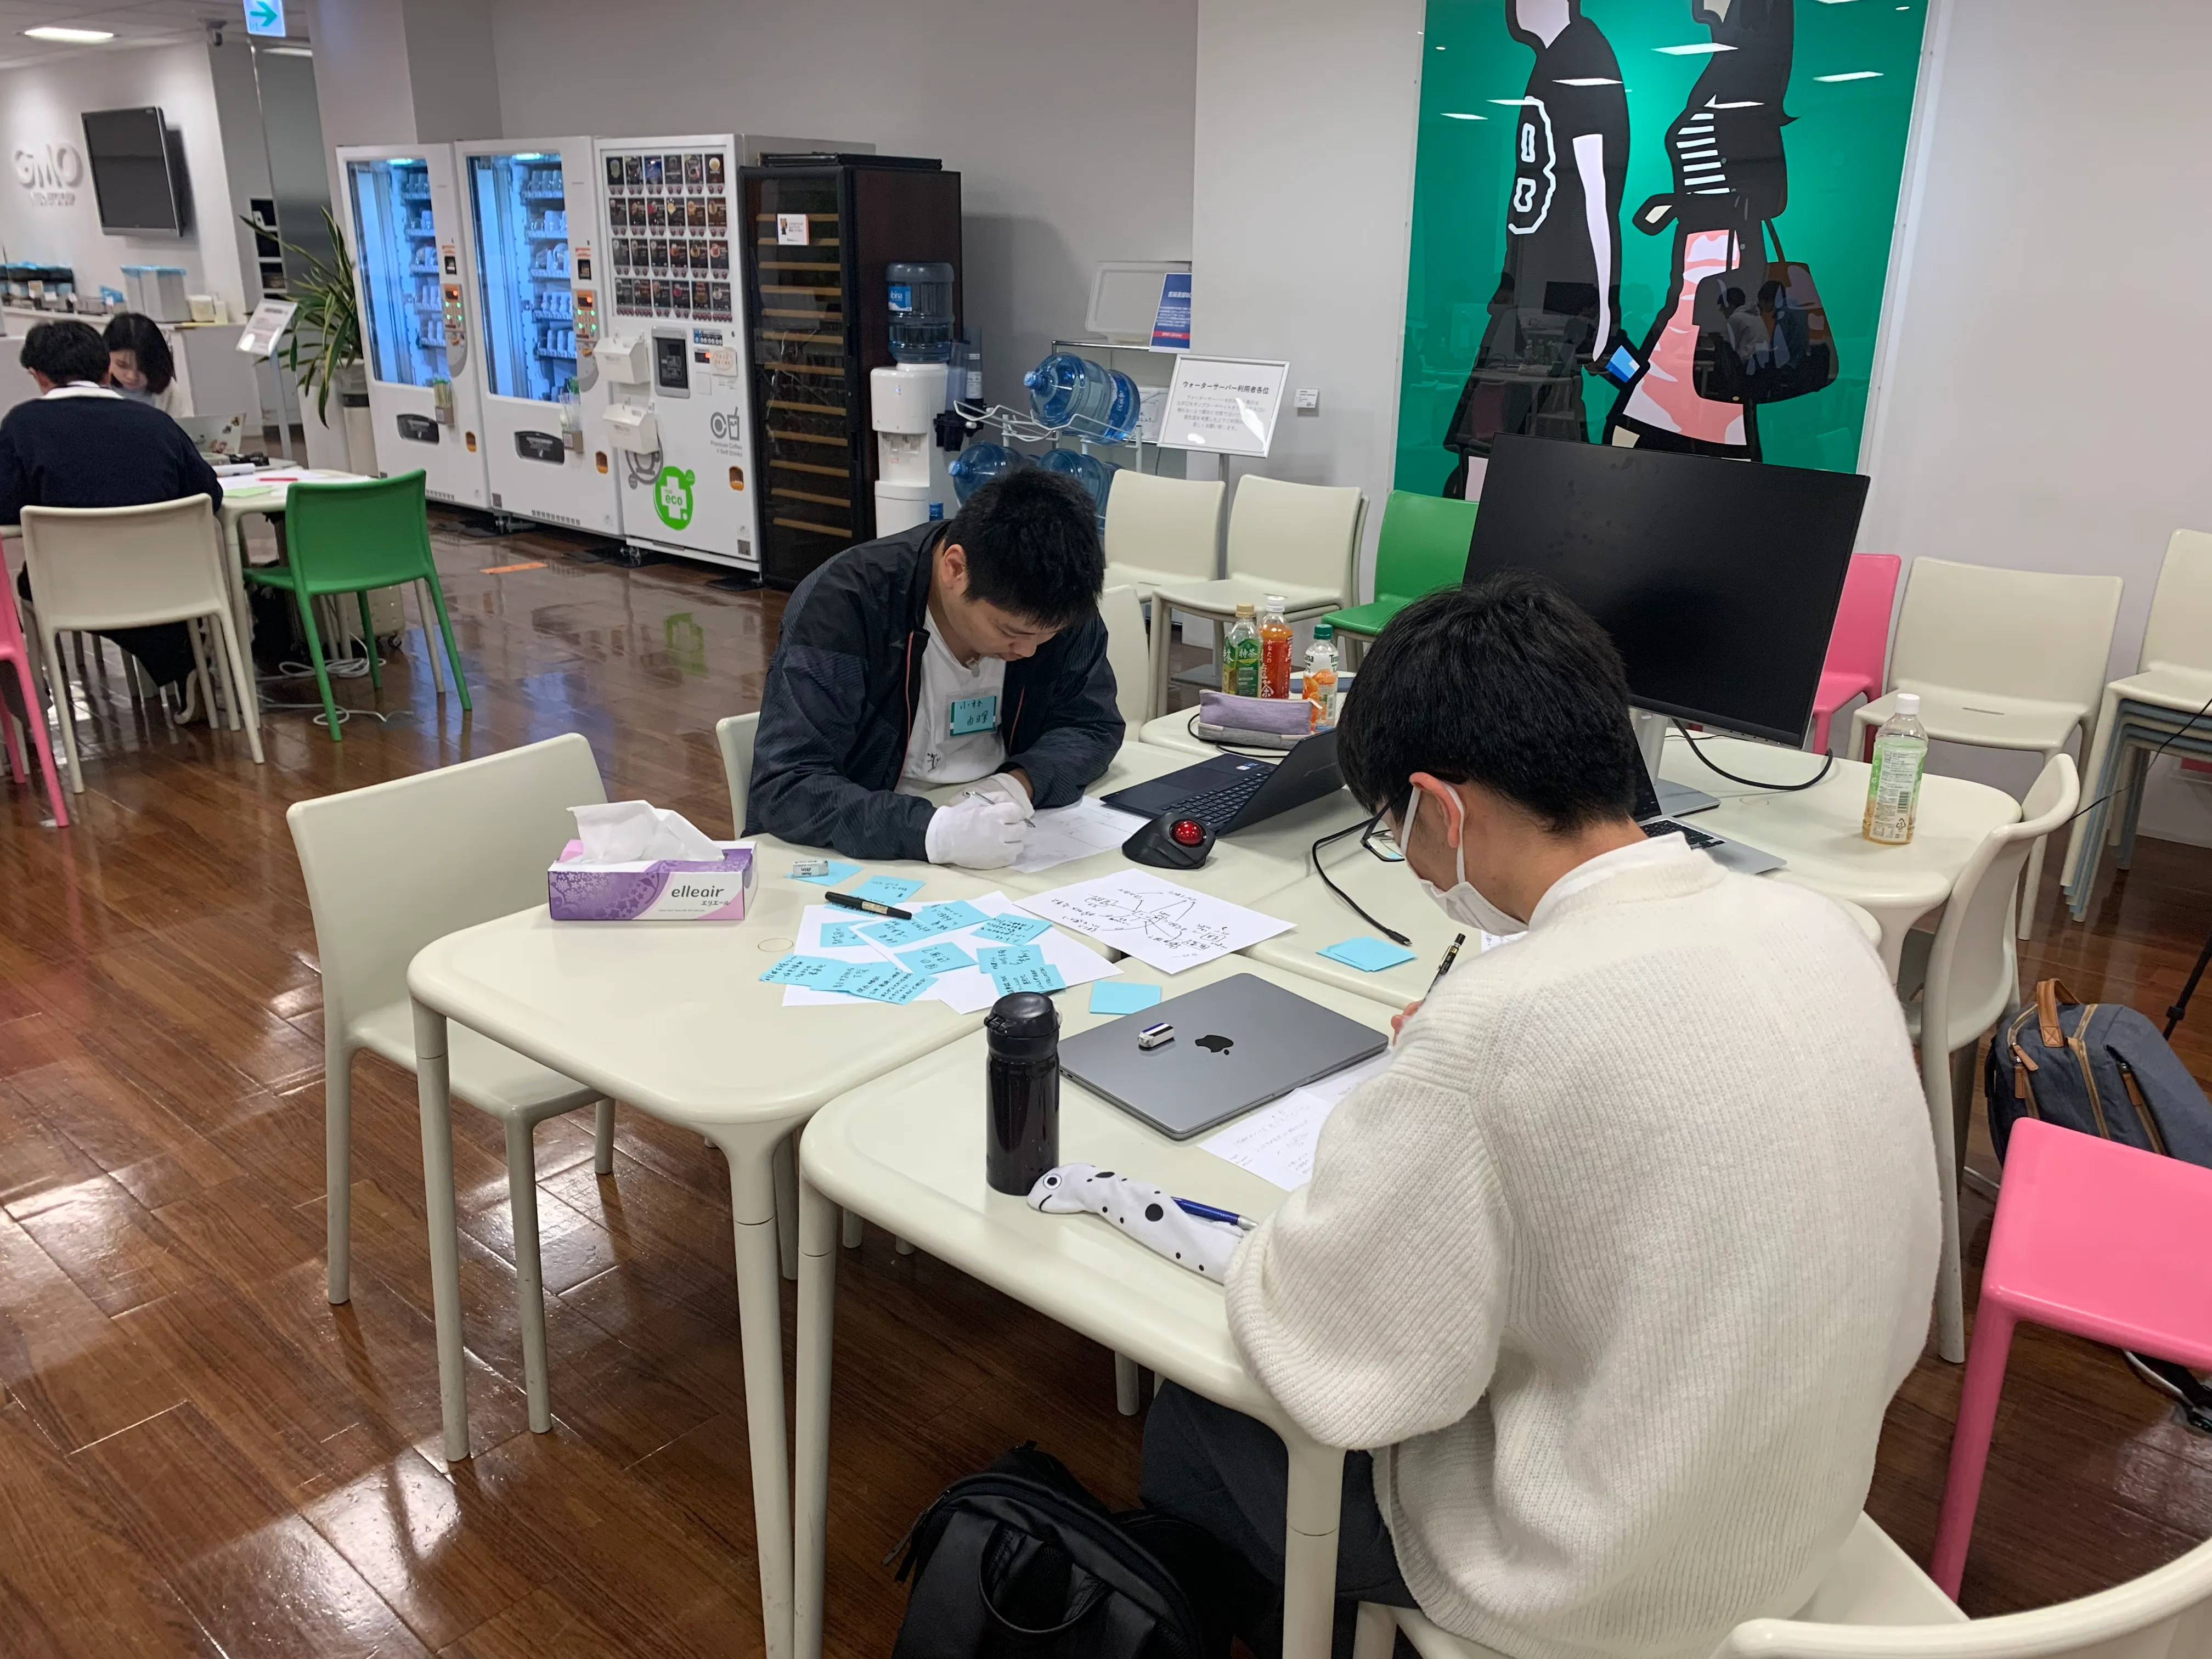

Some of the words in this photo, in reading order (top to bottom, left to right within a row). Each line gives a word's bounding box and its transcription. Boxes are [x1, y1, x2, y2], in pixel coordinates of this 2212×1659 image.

[13, 143, 83, 188] GMO
[1183, 381, 1269, 394] ウォーターサーバー利用者各位
[665, 494, 682, 506] eco
[1238, 648, 1257, 658] 特茶
[960, 699, 983, 709] 小林
[671, 885, 724, 898] elleair
